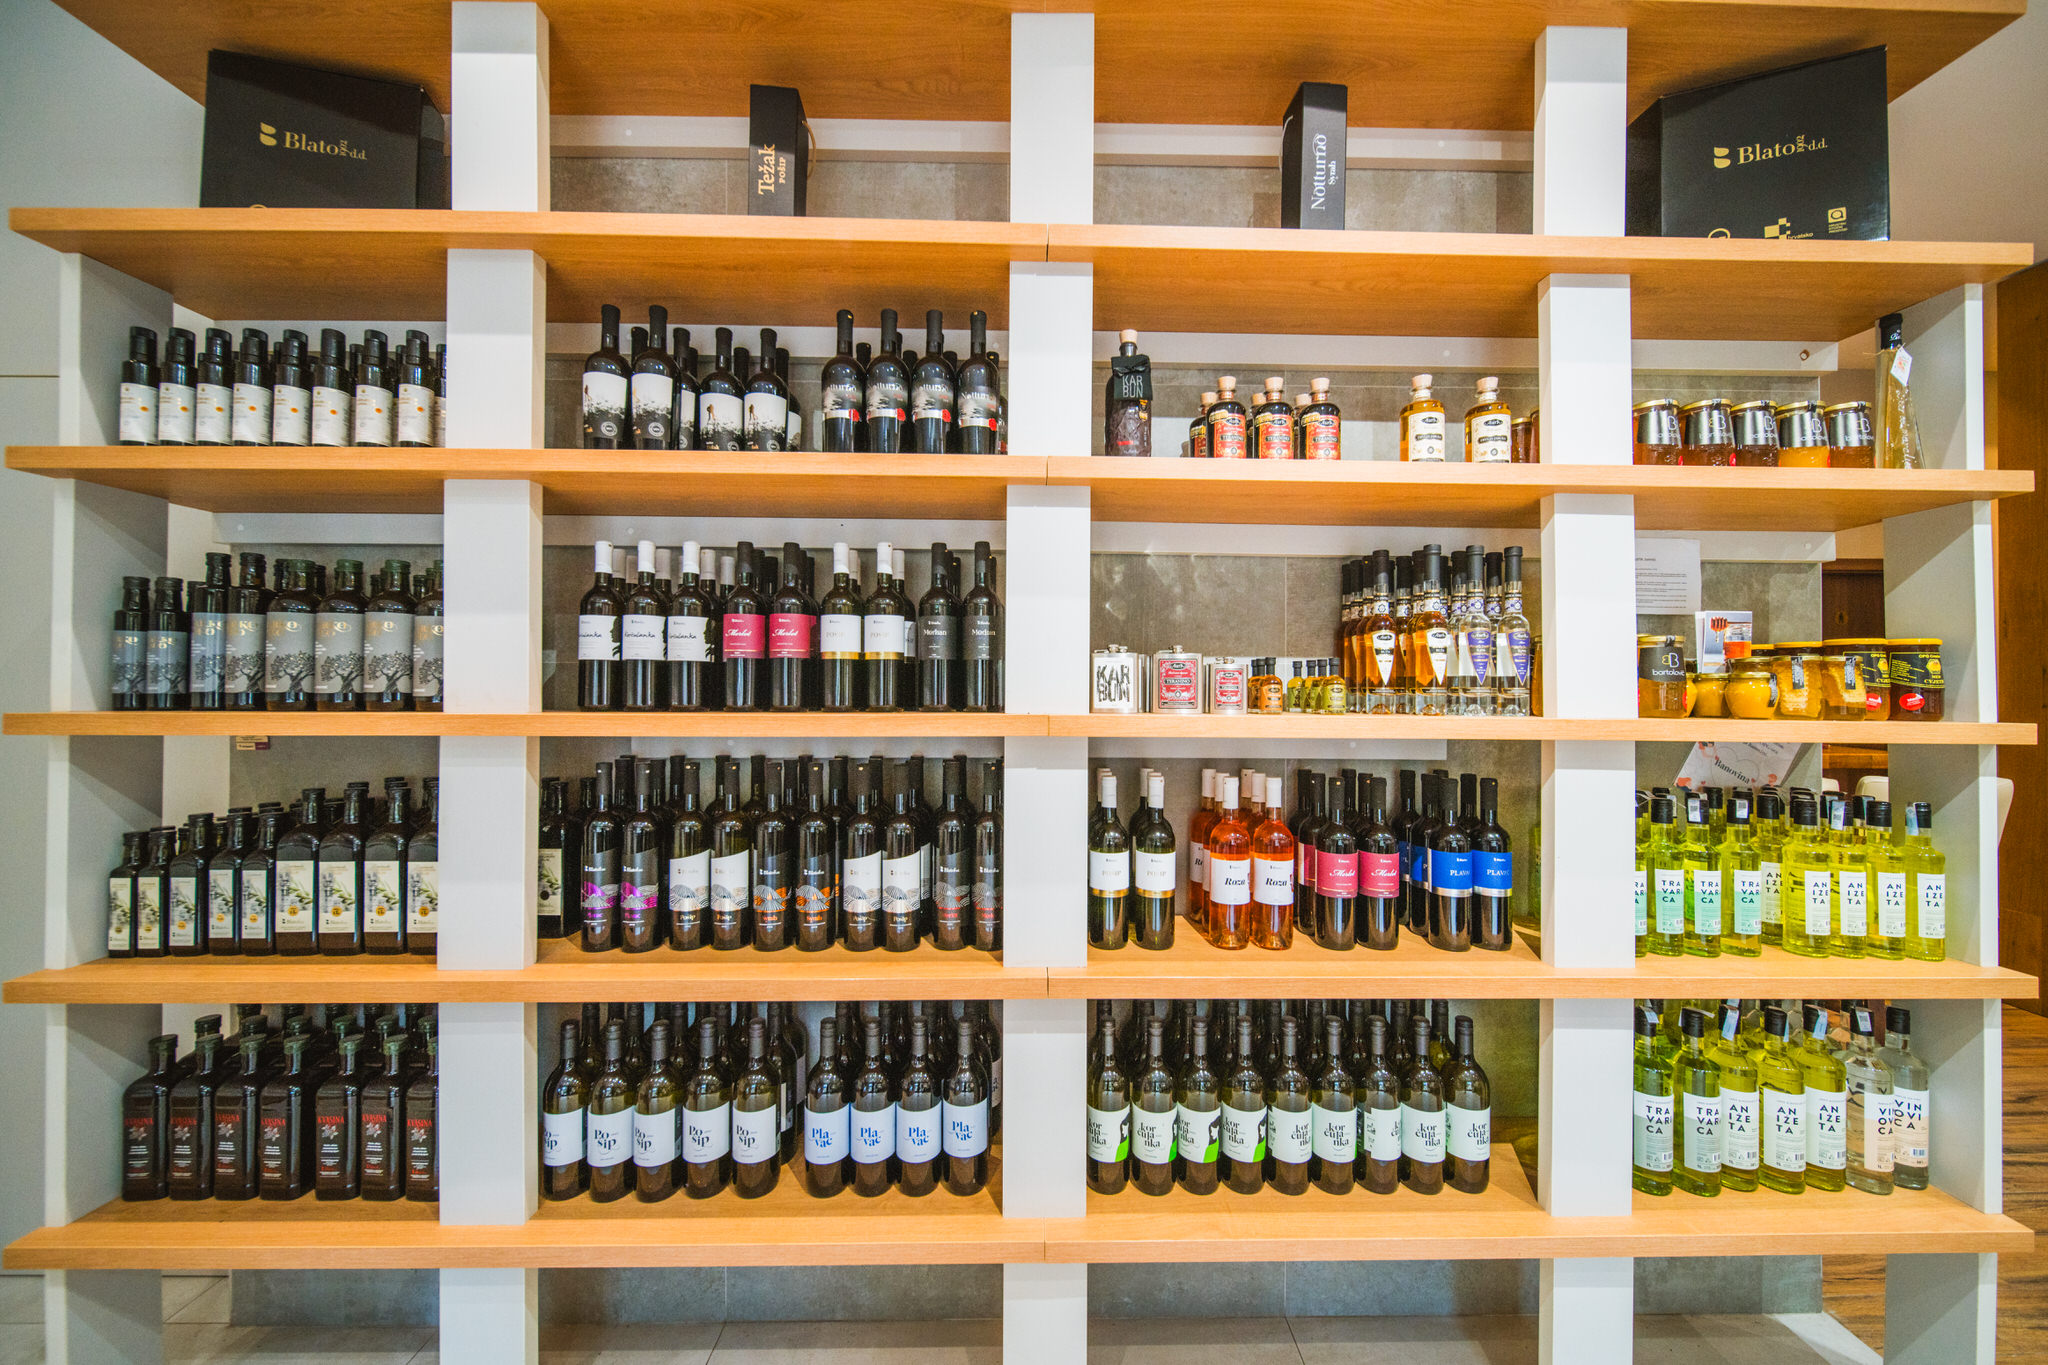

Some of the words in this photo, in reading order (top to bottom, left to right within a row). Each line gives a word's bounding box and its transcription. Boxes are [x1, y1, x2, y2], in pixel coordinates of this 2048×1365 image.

[284, 131, 338, 156] Blato
[1737, 143, 1796, 165] Blato
[758, 144, 775, 195] Težak
[1311, 133, 1327, 211] Notturno
[1122, 375, 1143, 387] KAR
[1122, 386, 1143, 398] BUN
[725, 629, 752, 637] Merlot
[772, 629, 799, 637] Merlot
[1714, 759, 1751, 785] Banovina
[1329, 869, 1356, 877] Merlot
[1371, 869, 1397, 877] Merlot
[1225, 877, 1246, 886] Roza
[1265, 877, 1287, 886] Roza
[1646, 1105, 1670, 1115] TRA
[1696, 1106, 1719, 1116] TRA
[1729, 1104, 1748, 1113] AN
[1777, 1106, 1797, 1115] AN
[1819, 1104, 1839, 1114] AN
[1894, 1099, 1922, 1112] VIN
[1728, 1112, 1751, 1123] IZE
[1776, 1114, 1799, 1126] IZE
[1819, 1112, 1841, 1123] IZE
[1894, 1109, 1921, 1121] OVI
[952, 1120, 970, 1132] Pla
[1140, 1122, 1157, 1133] kor
[1225, 1117, 1240, 1128] kor
[1295, 1123, 1309, 1133] kor
[1327, 1122, 1346, 1133] kor
[1419, 1123, 1437, 1132] kor
[1472, 1123, 1487, 1132] kor
[1728, 1121, 1746, 1132] TA
[1818, 1122, 1836, 1132] TA
[1894, 1118, 1916, 1130] CA
[594, 1129, 610, 1140] Po
[634, 1128, 647, 1139] Po
[689, 1125, 703, 1136] Po
[736, 1125, 750, 1136] Po
[812, 1127, 830, 1139] Pla
[860, 1127, 878, 1138] Pla
[908, 1126, 926, 1138] Pla
[1646, 1125, 1663, 1135] CA
[1696, 1126, 1713, 1136] CA
[1776, 1124, 1794, 1135] TA
[863, 1136, 882, 1147] vac
[911, 1136, 929, 1147] vac
[954, 1131, 973, 1141] vac
[1091, 1135, 1107, 1145] nka
[1180, 1133, 1195, 1144] nka
[1228, 1134, 1244, 1145] nka
[1333, 1136, 1350, 1147] nka
[1425, 1136, 1441, 1147] nka
[814, 1137, 833, 1148] vac
[1144, 1137, 1161, 1148] nka
